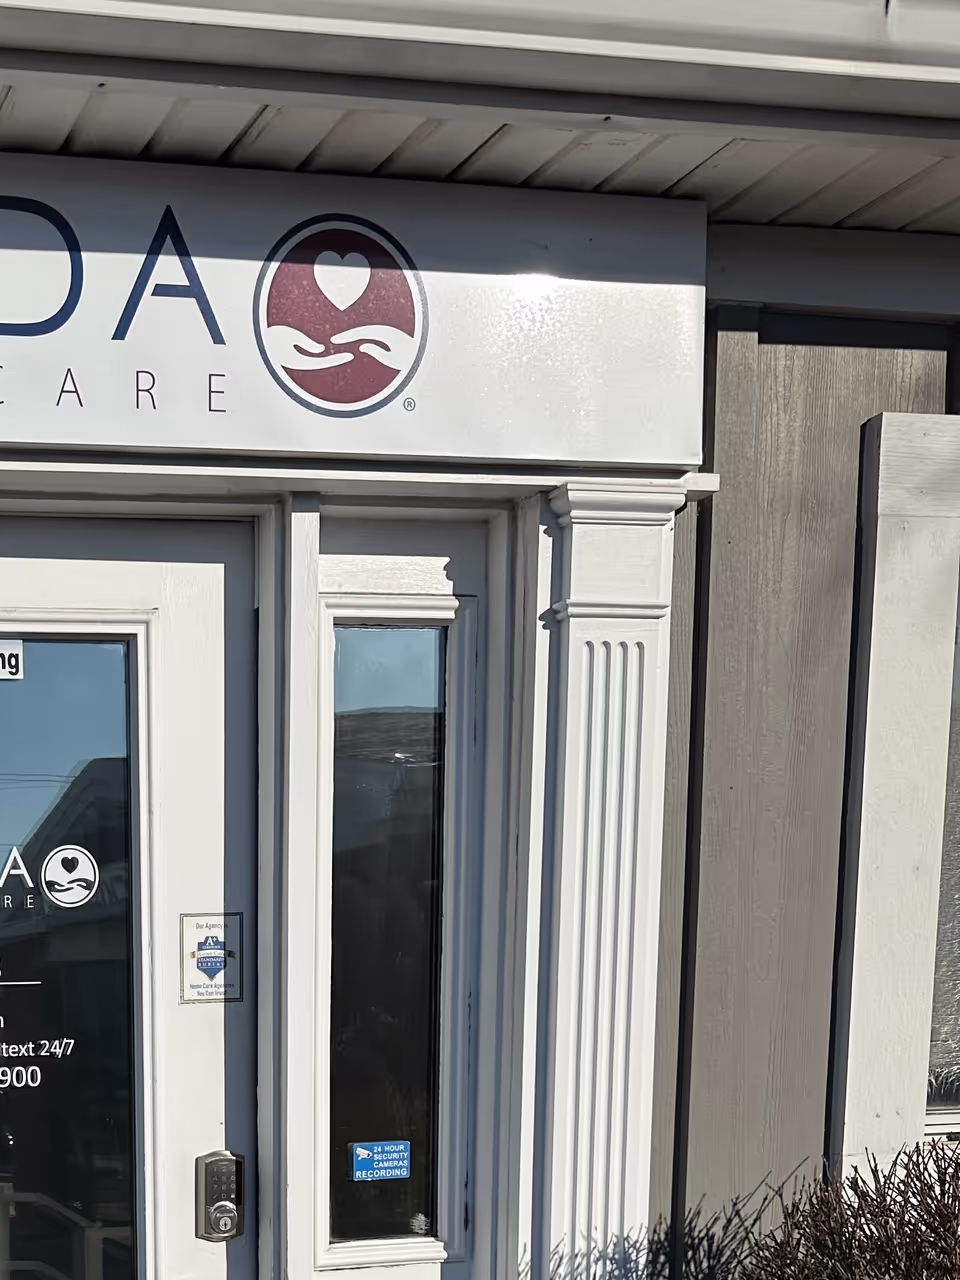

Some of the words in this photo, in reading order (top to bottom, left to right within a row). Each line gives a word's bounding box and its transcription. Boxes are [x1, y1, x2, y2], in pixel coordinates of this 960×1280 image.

[1, 1042, 35, 1058] text
[39, 1037, 75, 1059] 24/7
[373, 1145, 382, 1153] 24
[384, 1144, 405, 1152] HOUR
[373, 1152, 409, 1161] SECURITY
[373, 1159, 409, 1168] CAMERAS
[355, 1168, 408, 1179] RECORDING
